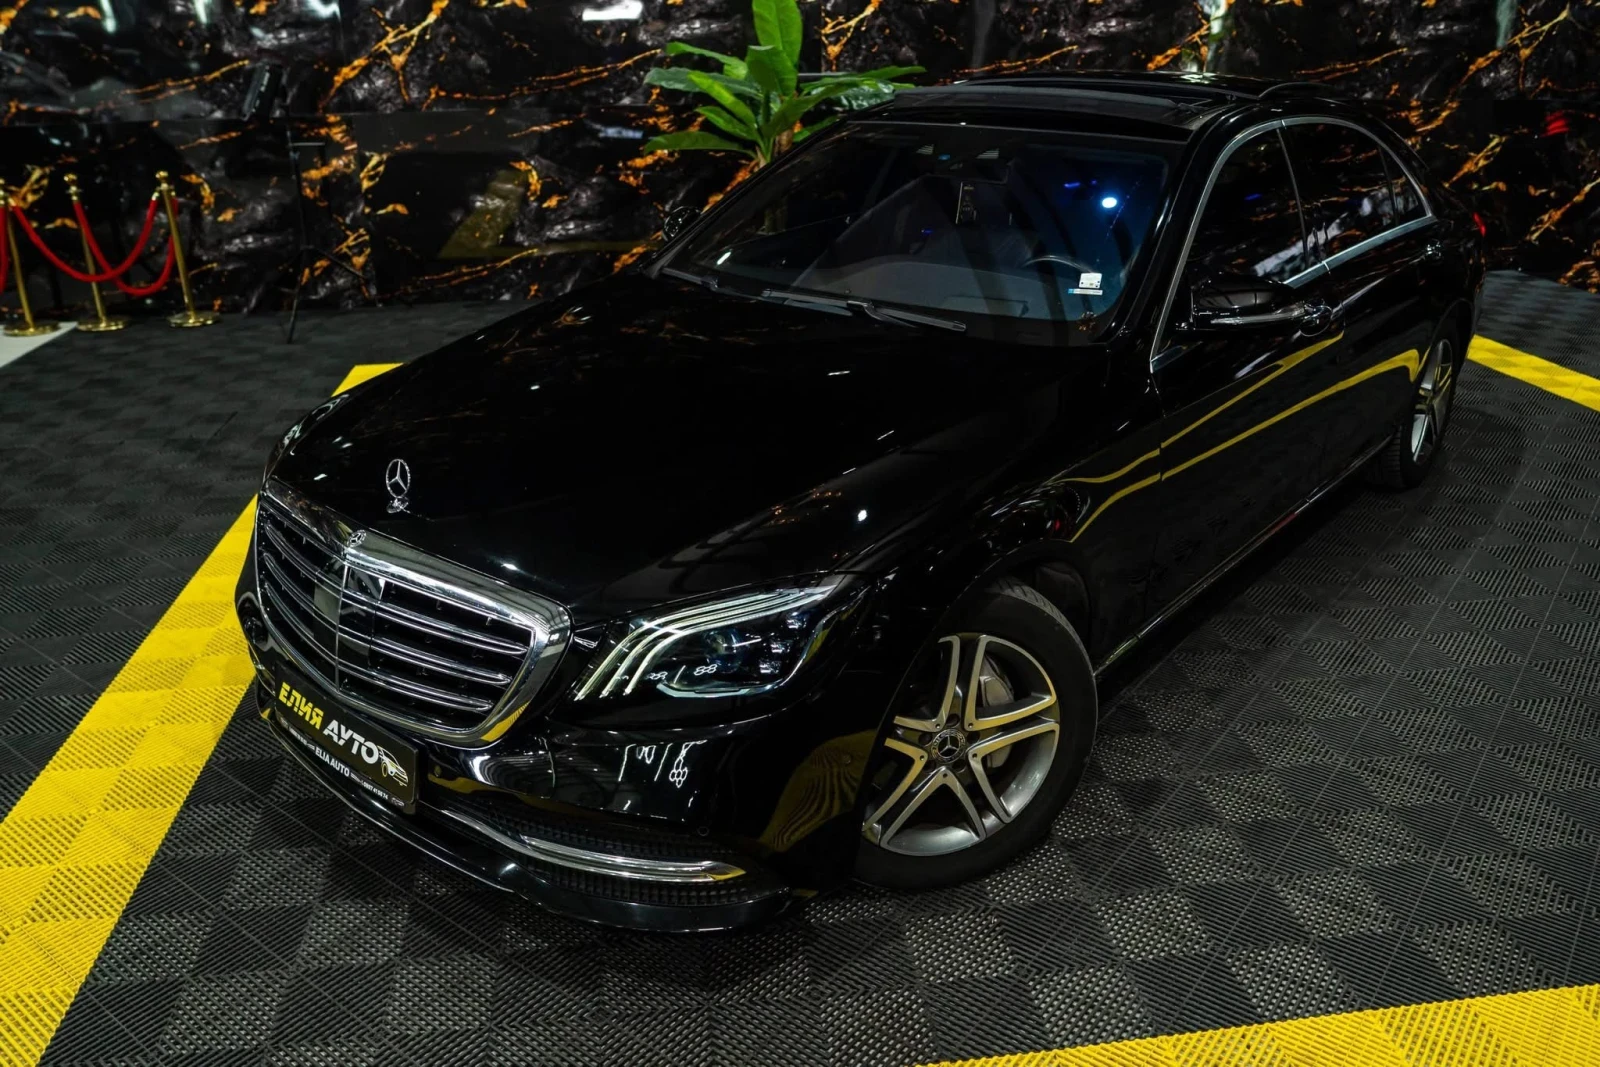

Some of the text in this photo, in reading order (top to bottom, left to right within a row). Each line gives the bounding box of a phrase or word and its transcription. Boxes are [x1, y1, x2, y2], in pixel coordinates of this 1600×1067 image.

[279, 682, 324, 730] ЕЛИЯ
[323, 720, 379, 764] АУТО
[315, 746, 350, 777] ELIA AUTO
